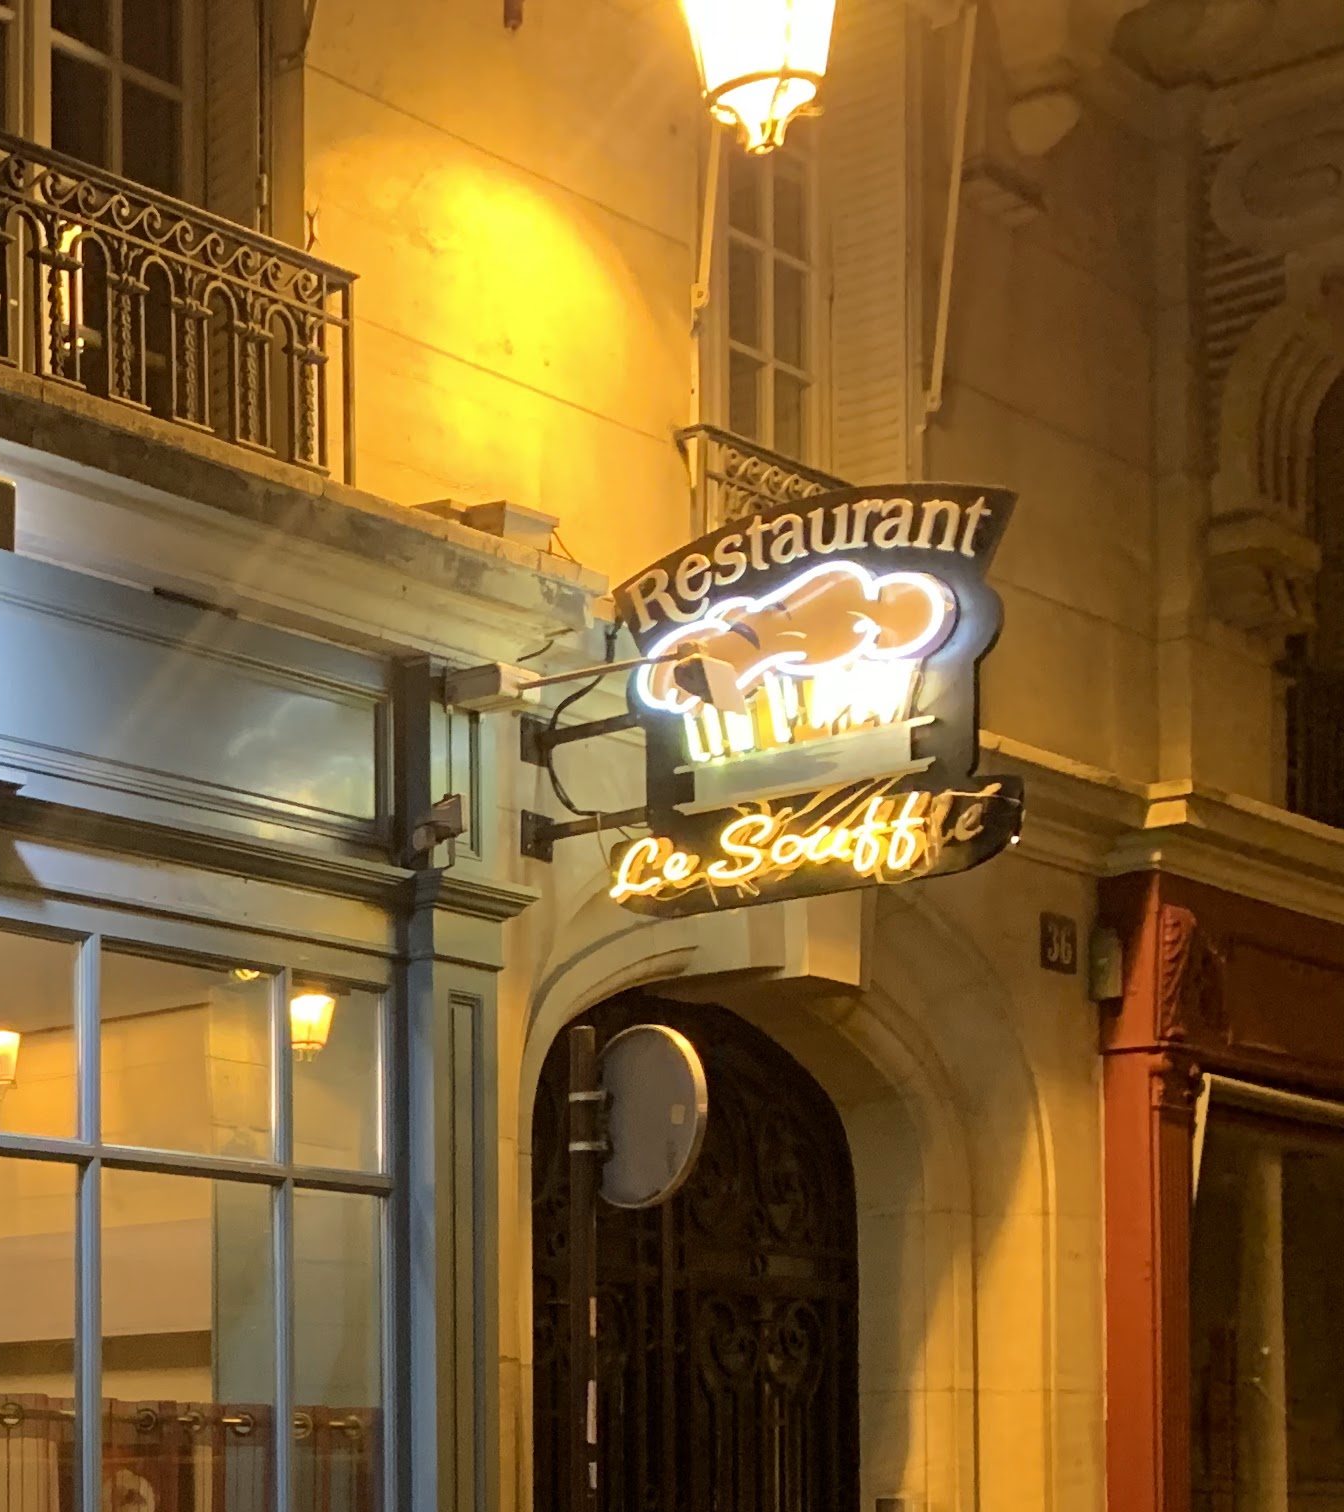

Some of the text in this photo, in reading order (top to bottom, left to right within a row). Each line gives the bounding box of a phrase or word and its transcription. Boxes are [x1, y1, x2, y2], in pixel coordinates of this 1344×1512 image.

[624, 495, 993, 634] Restaurant
[609, 834, 699, 902] Le
[1047, 922, 1073, 965] 36
